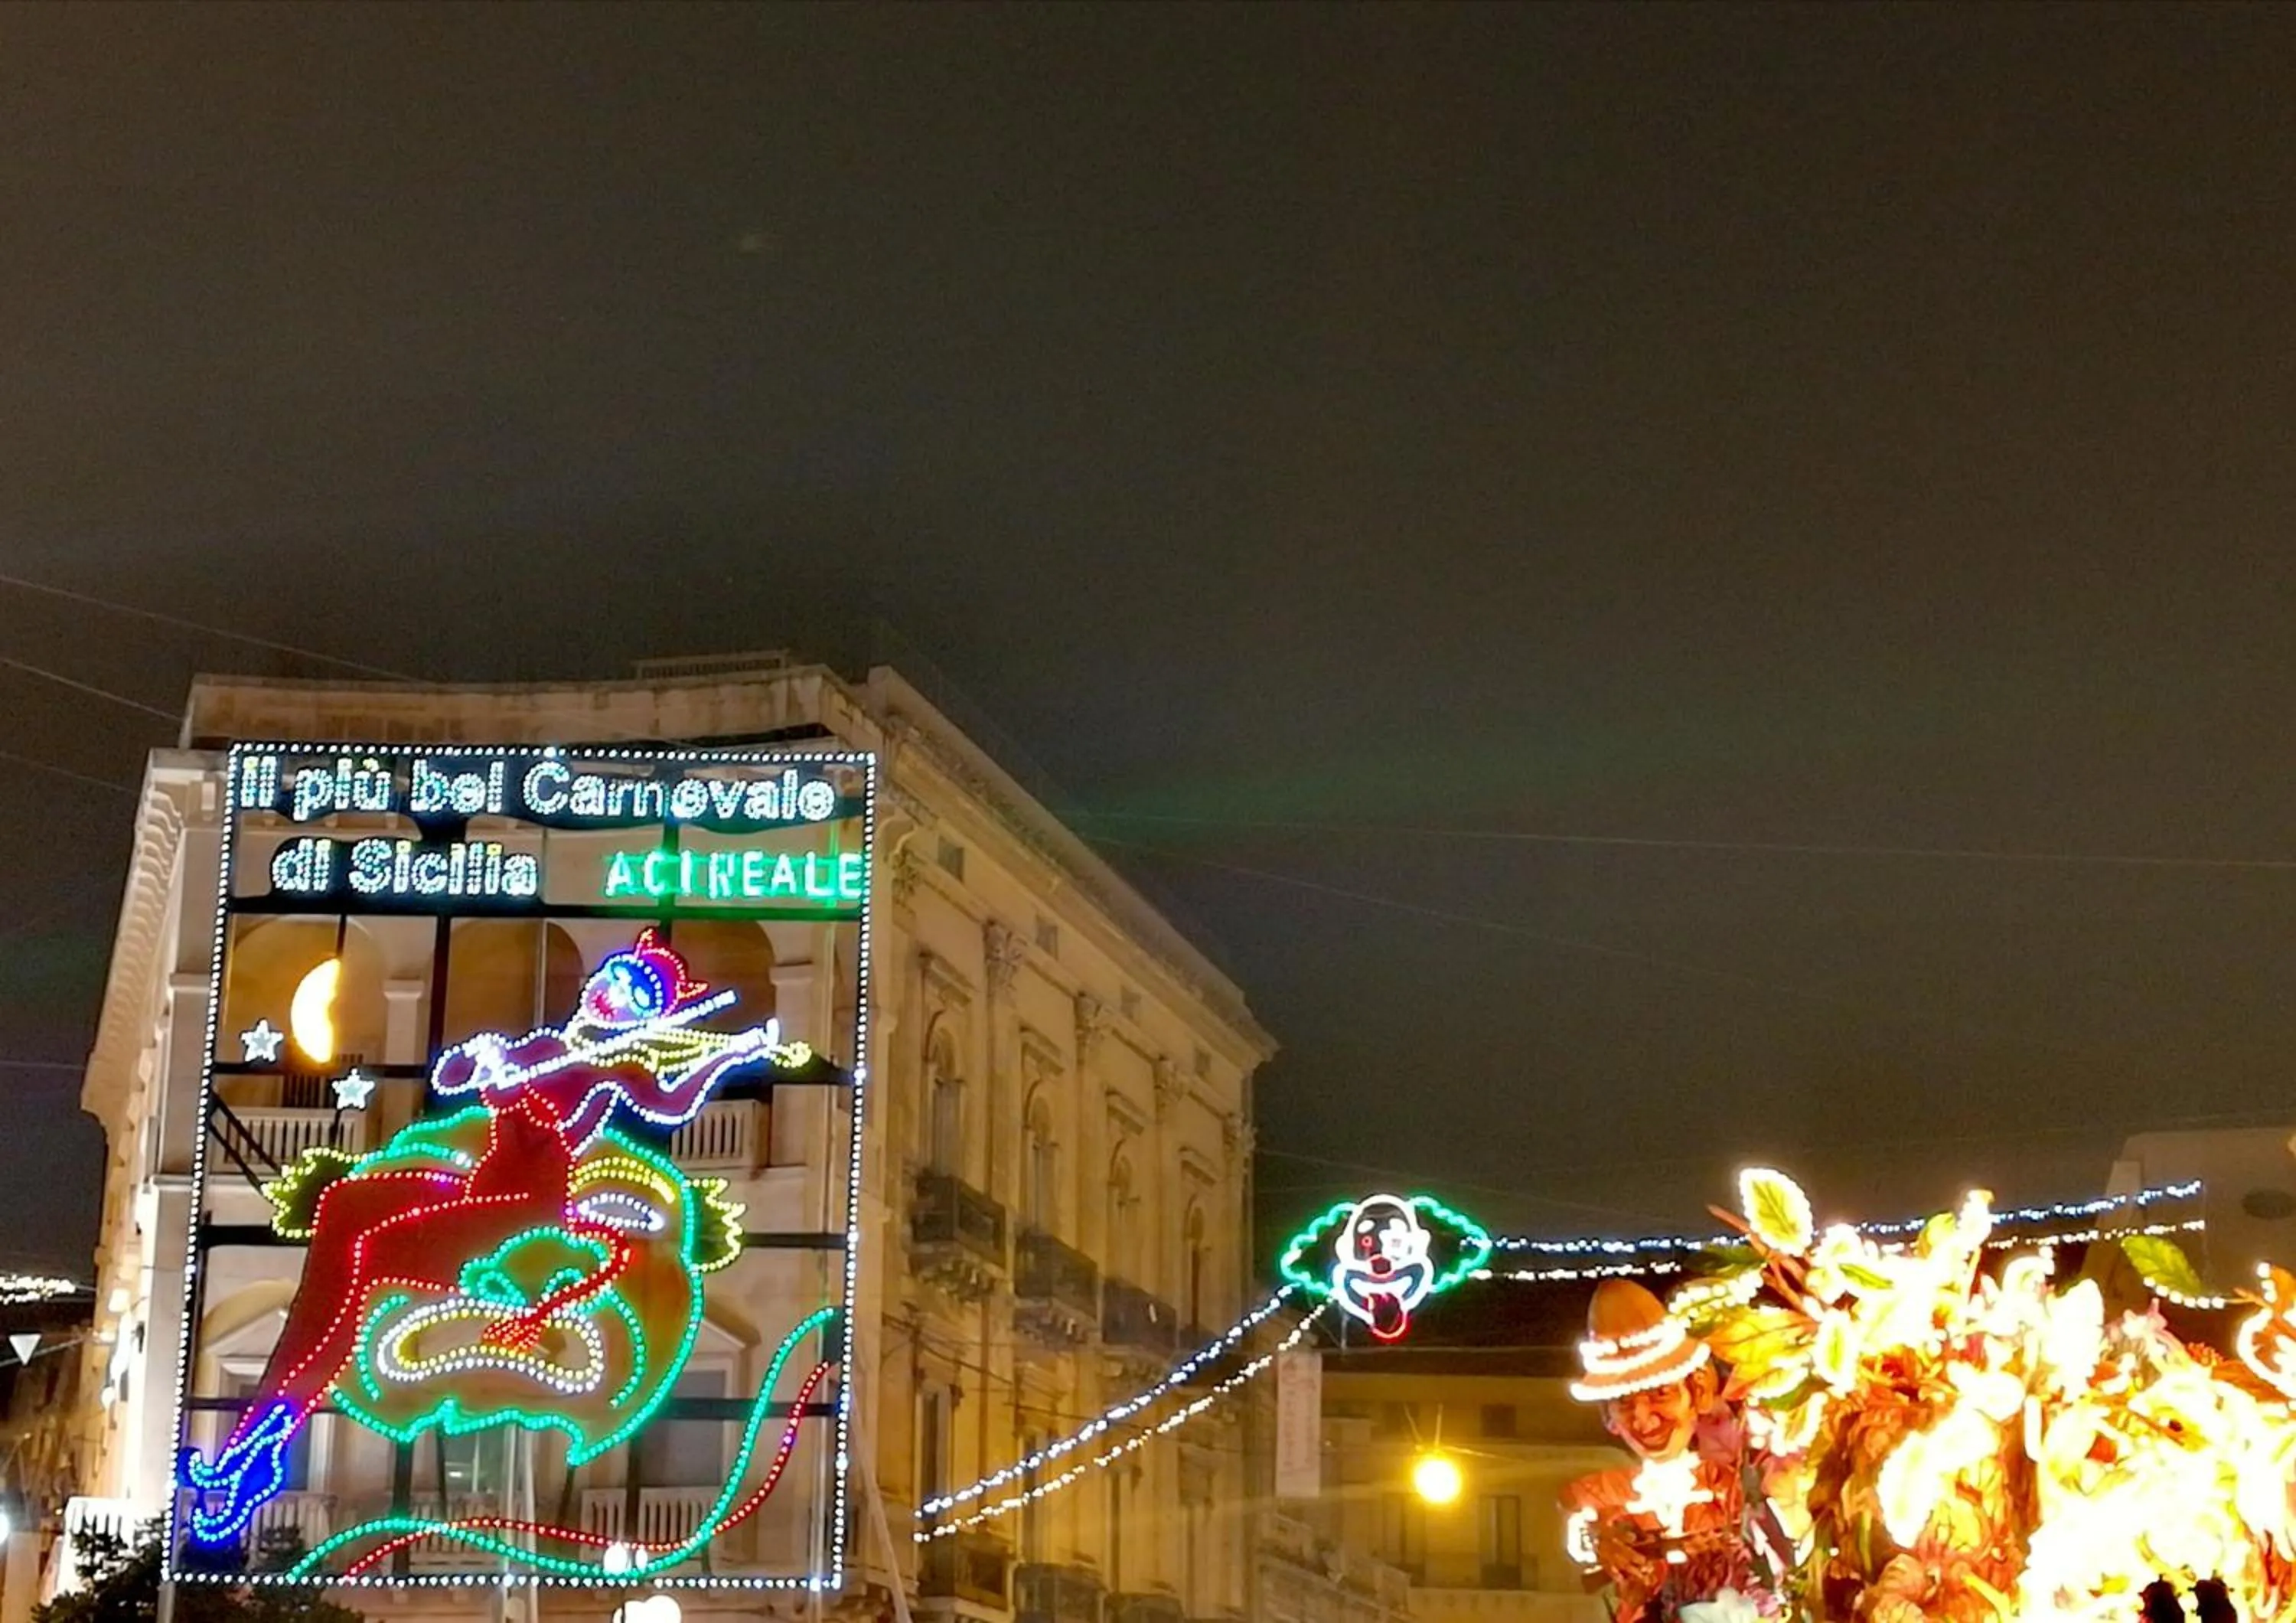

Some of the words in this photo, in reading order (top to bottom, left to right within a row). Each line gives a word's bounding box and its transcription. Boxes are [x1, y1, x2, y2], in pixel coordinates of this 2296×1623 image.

[293, 756, 391, 821] più
[410, 759, 504, 813] bel
[523, 761, 836, 821] Carnevale
[272, 838, 331, 891] di
[349, 839, 536, 895] Sicilia
[605, 850, 863, 899] ACIREALE
